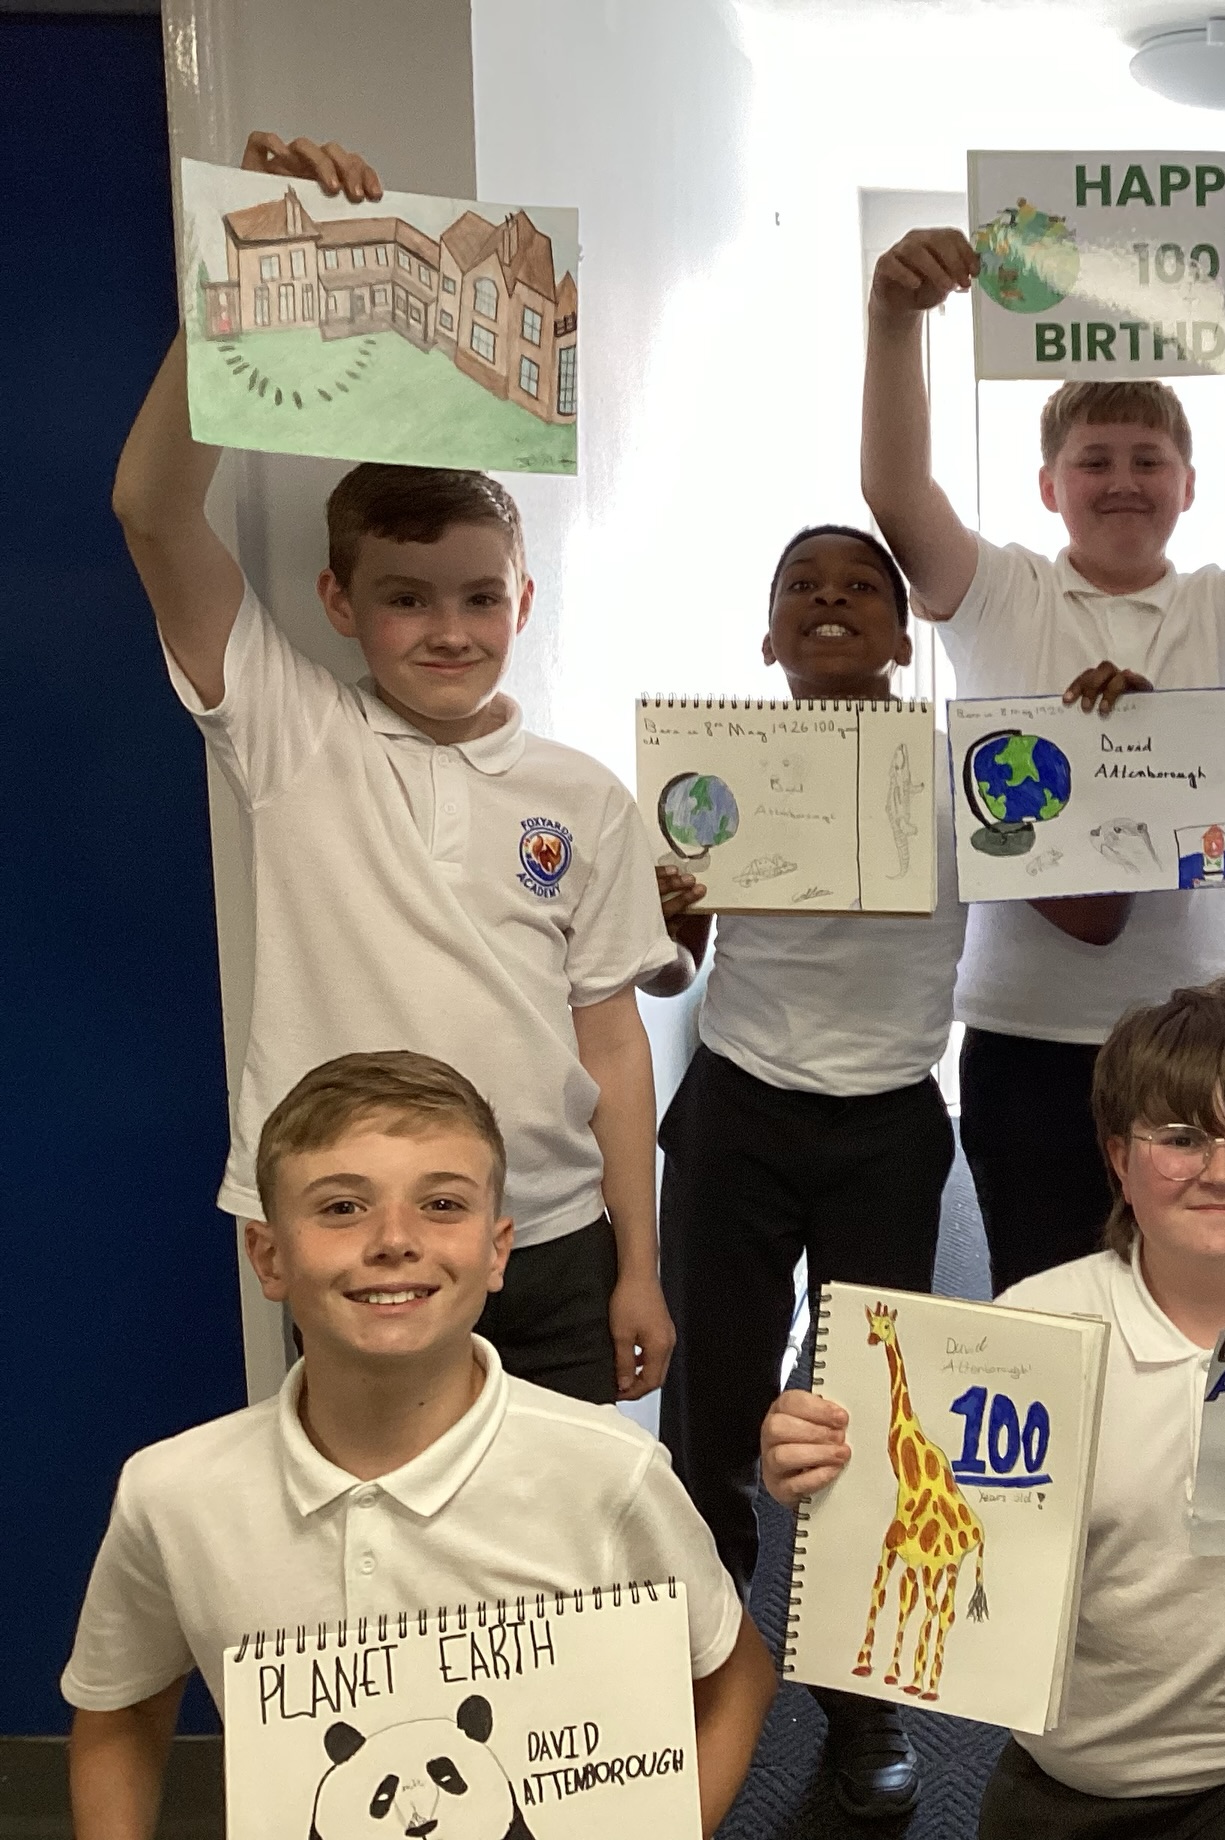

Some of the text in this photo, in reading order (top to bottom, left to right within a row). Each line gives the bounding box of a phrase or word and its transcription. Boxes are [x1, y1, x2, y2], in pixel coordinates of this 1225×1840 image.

[1132, 242, 1221, 285] 100
[772, 721, 809, 734] 1926
[814, 720, 835, 732] 100
[1100, 733, 1152, 753] David
[1094, 763, 1207, 790] Attenborough
[520, 817, 574, 842] FOXYARDS
[516, 873, 561, 898] ACADEMY
[949, 1385, 1051, 1475] 100
[258, 1620, 558, 1725] PLANET EARTH
[527, 1721, 600, 1762] DAVID
[522, 1748, 685, 1807] ATTENBOROUGH
